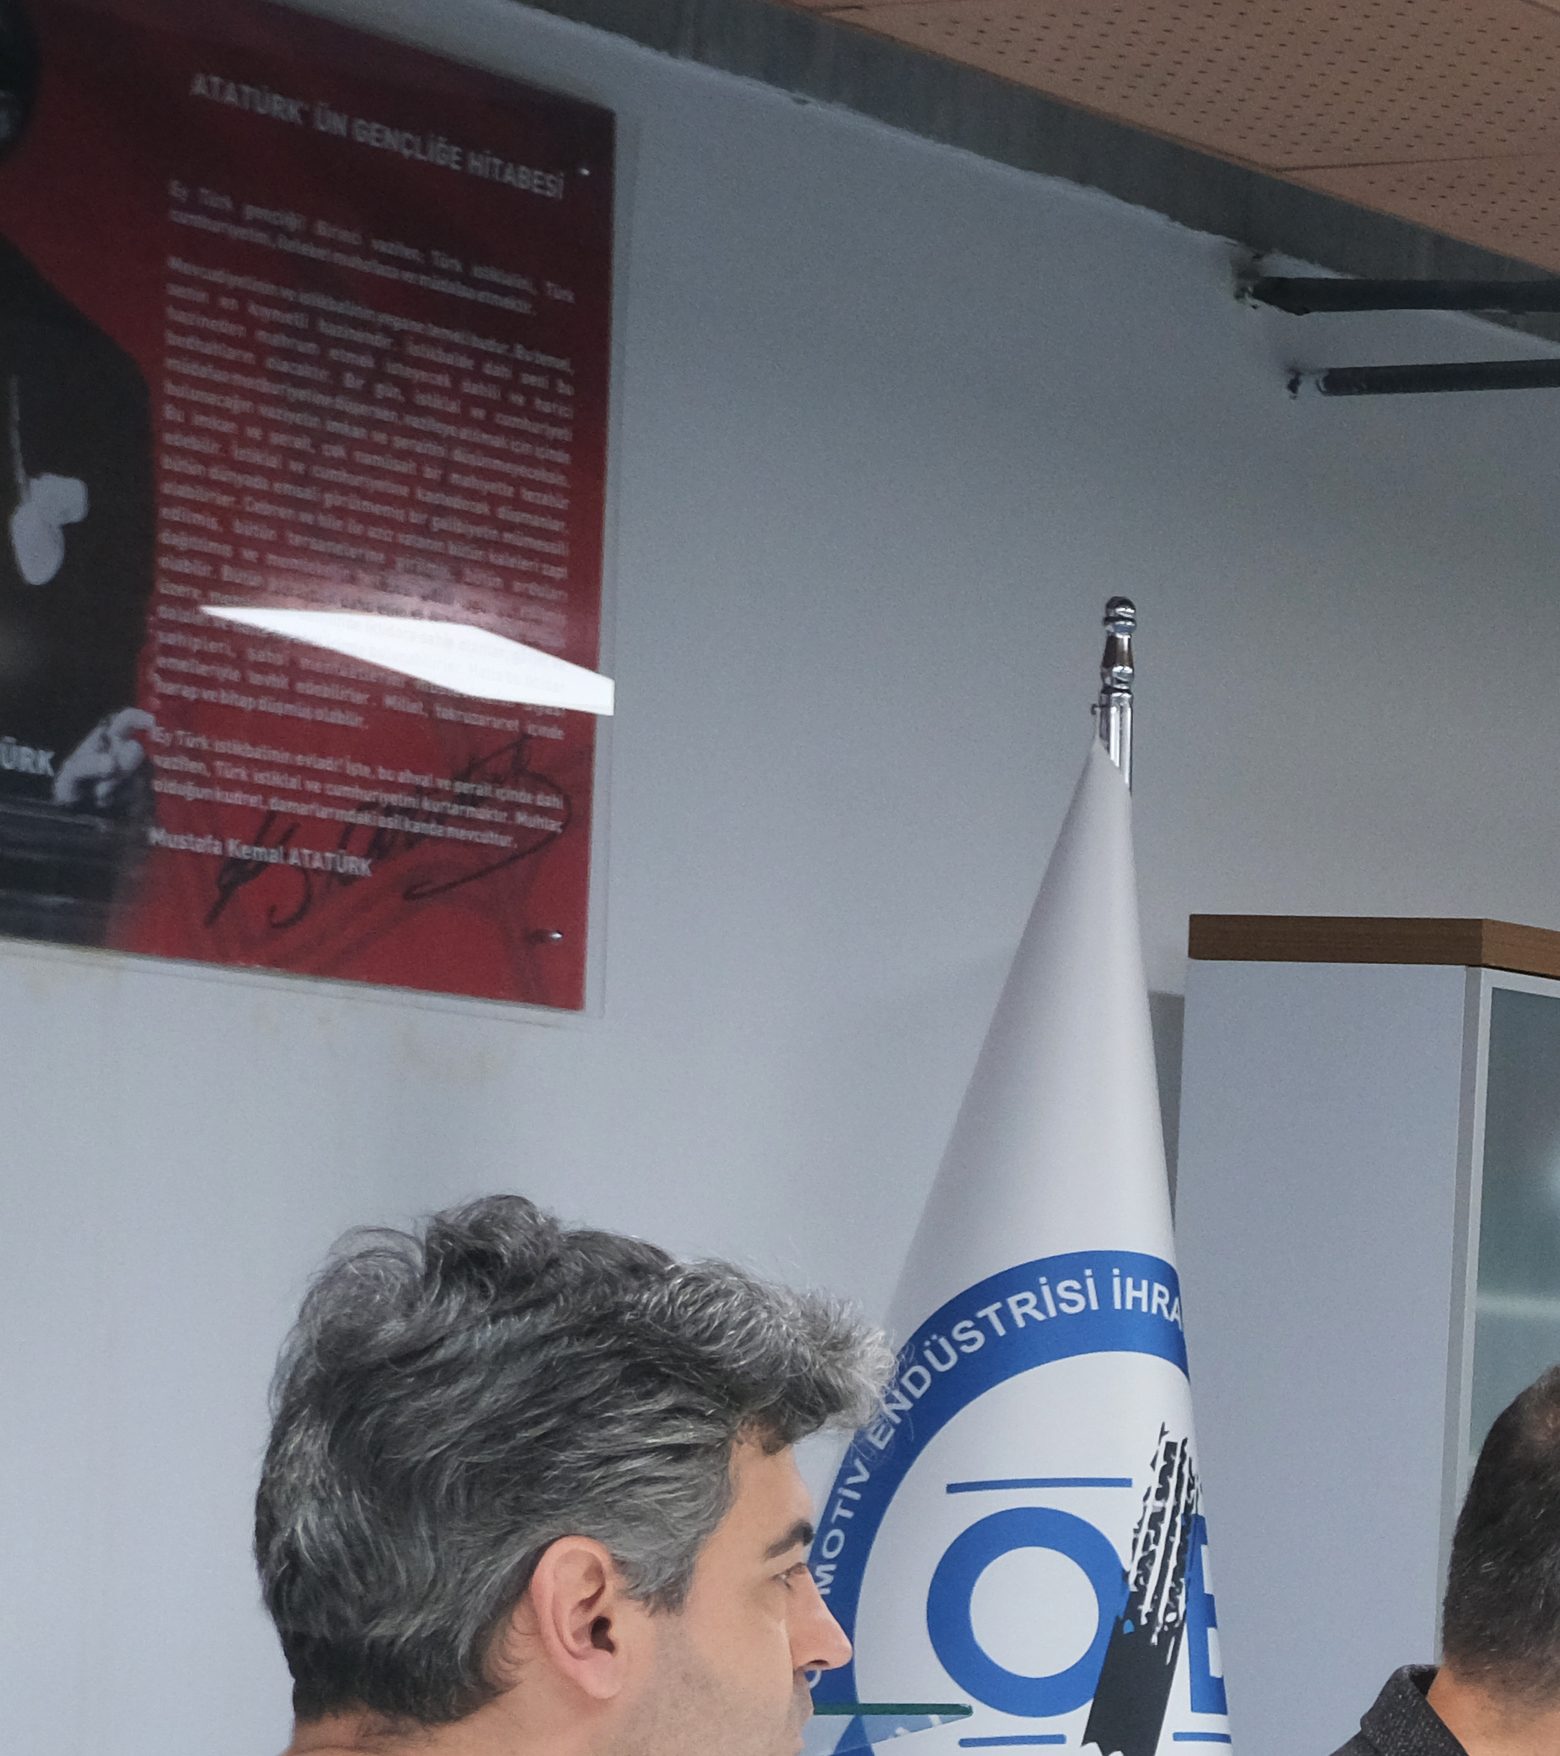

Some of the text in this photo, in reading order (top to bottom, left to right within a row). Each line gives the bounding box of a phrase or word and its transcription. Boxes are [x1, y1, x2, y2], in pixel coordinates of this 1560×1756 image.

[352, 117, 462, 170] GENÇLİĞE
[467, 150, 564, 199] HİTABESİ
[147, 824, 372, 877] Mustafa Kemal ATATÜRK
[867, 1268, 1099, 1452] ENDÜSTRİSİ
